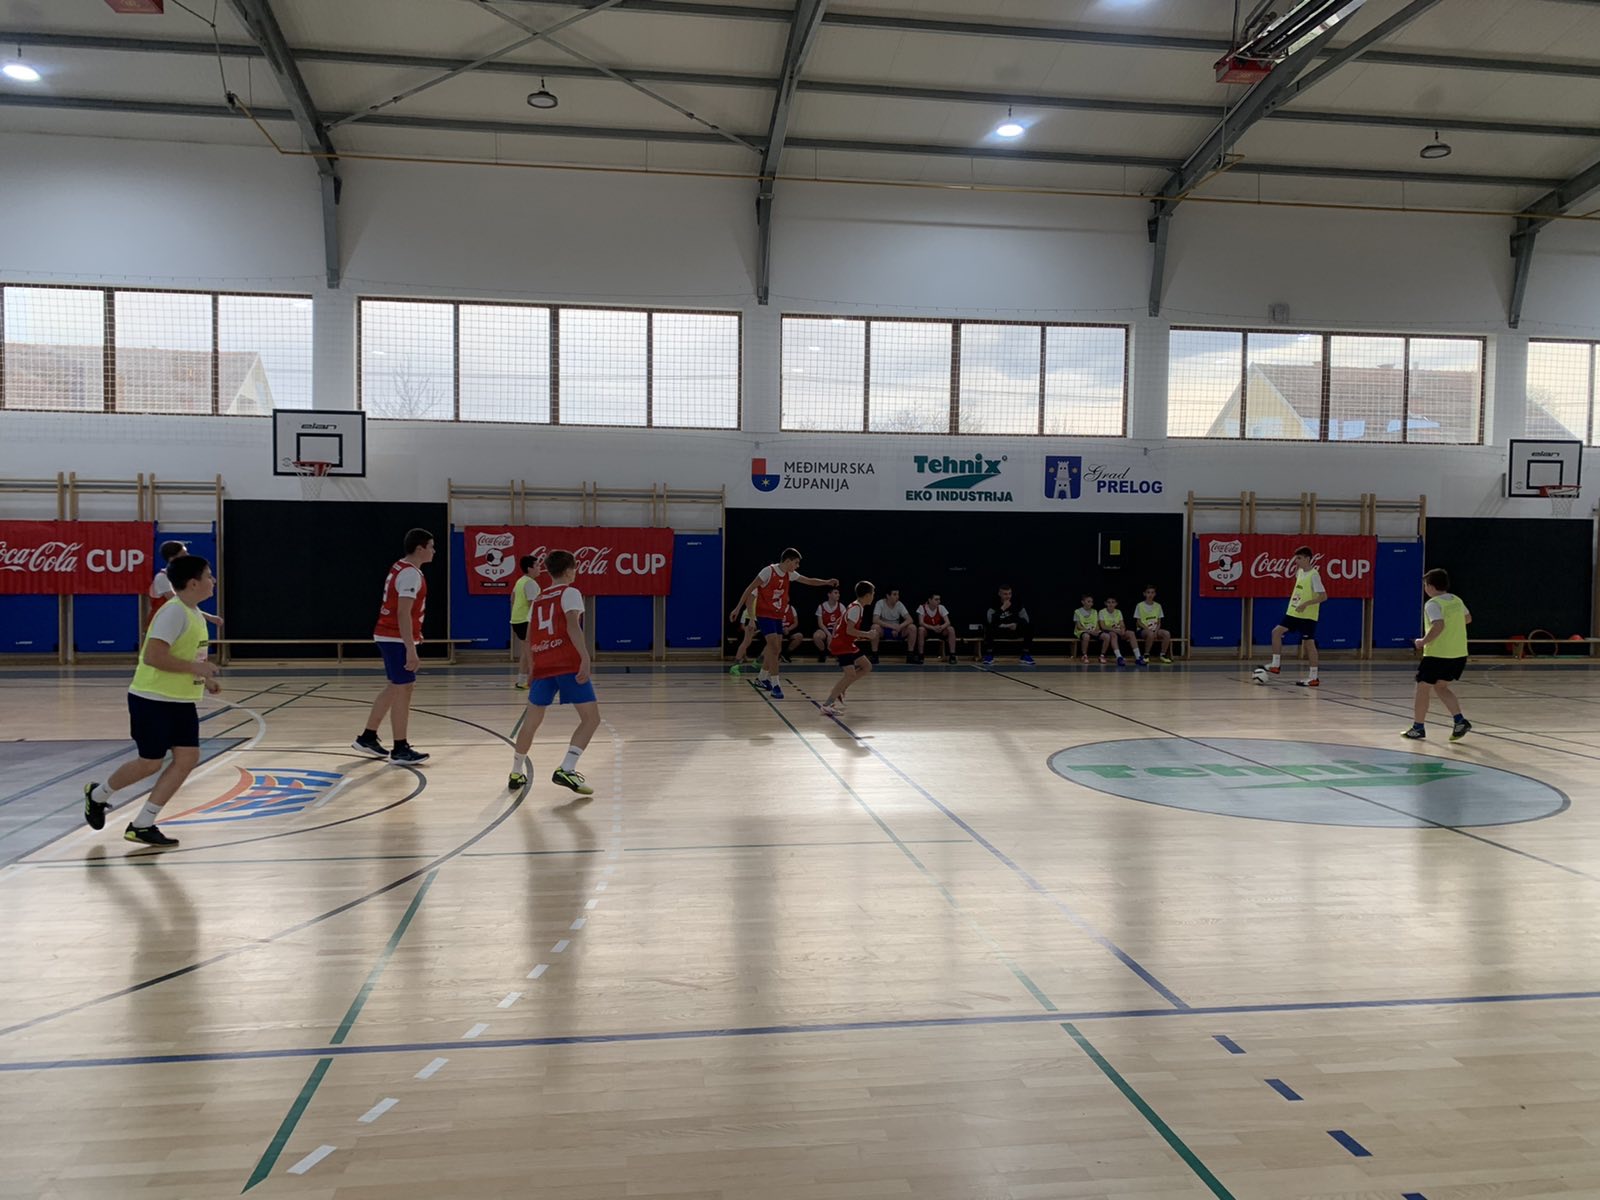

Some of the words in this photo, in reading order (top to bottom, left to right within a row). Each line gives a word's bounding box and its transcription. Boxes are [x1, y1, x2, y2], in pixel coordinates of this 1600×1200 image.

[784, 461, 875, 475] MEĐIMURSKA
[1083, 463, 1131, 482] Grad
[784, 475, 850, 493] ŽUPANIJA
[1096, 480, 1163, 494] PRELOG
[905, 490, 932, 501] EKO
[936, 490, 1014, 502] INDUSTRIJA
[86, 549, 145, 572] CUP
[615, 553, 666, 575] CUP
[1326, 559, 1371, 580] CUP
[537, 603, 554, 635] 4
[1067, 759, 1475, 779] Tehnix
